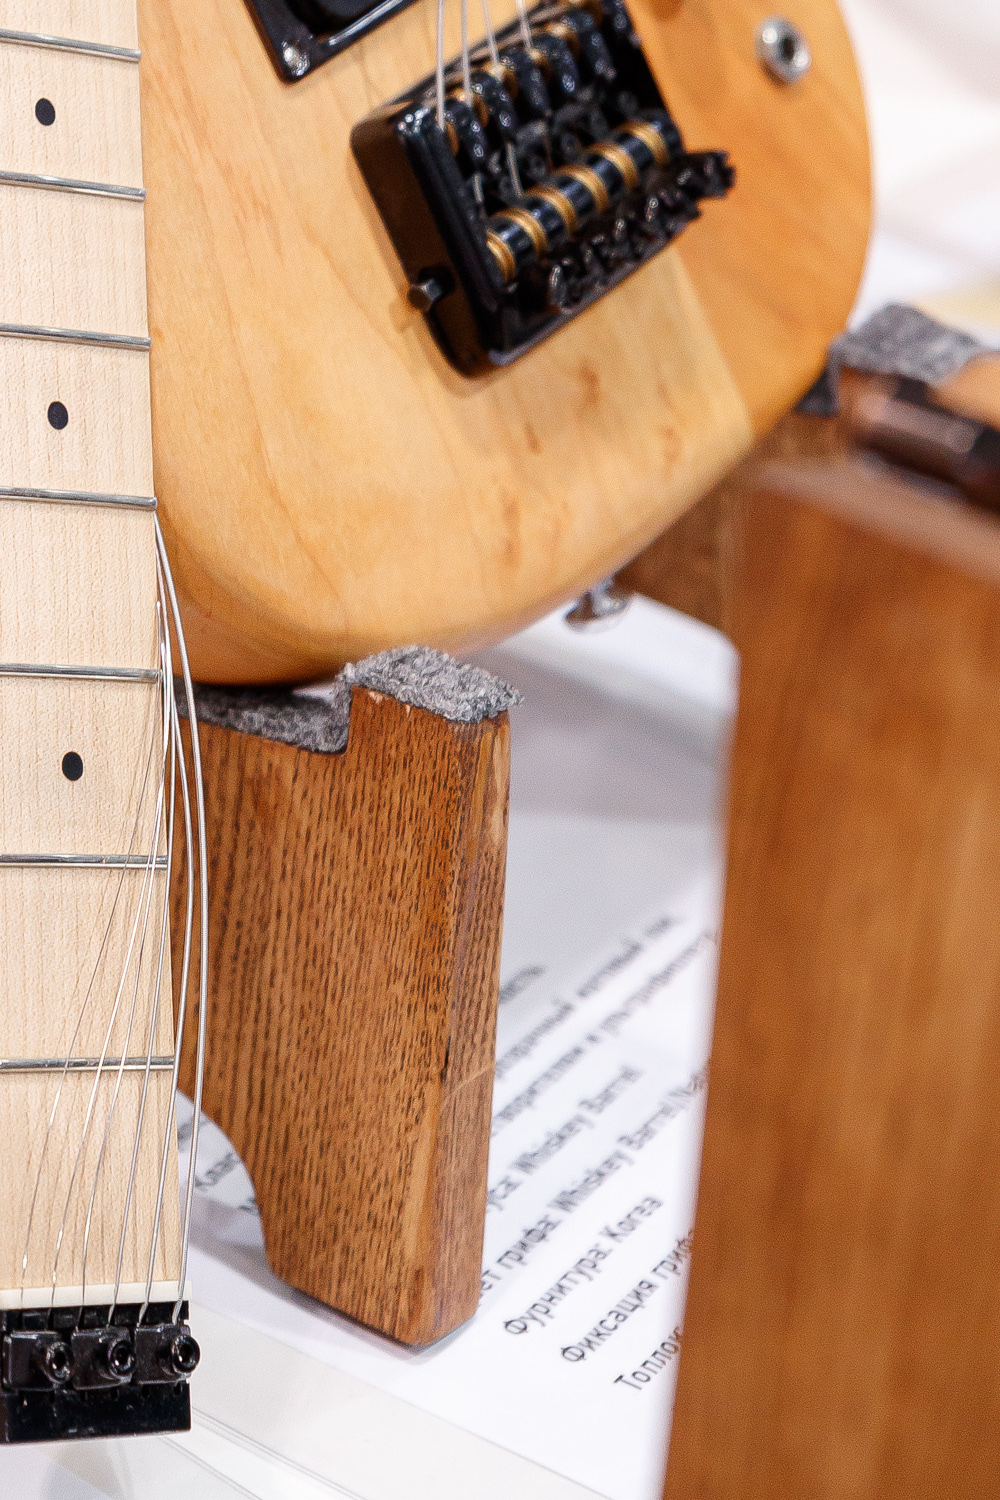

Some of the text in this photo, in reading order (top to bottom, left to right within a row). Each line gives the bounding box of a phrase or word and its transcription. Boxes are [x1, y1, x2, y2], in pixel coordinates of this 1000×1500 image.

[503, 1195, 664, 1336] Фурнитура: Korea
[560, 1278, 660, 1363] Фиксация
